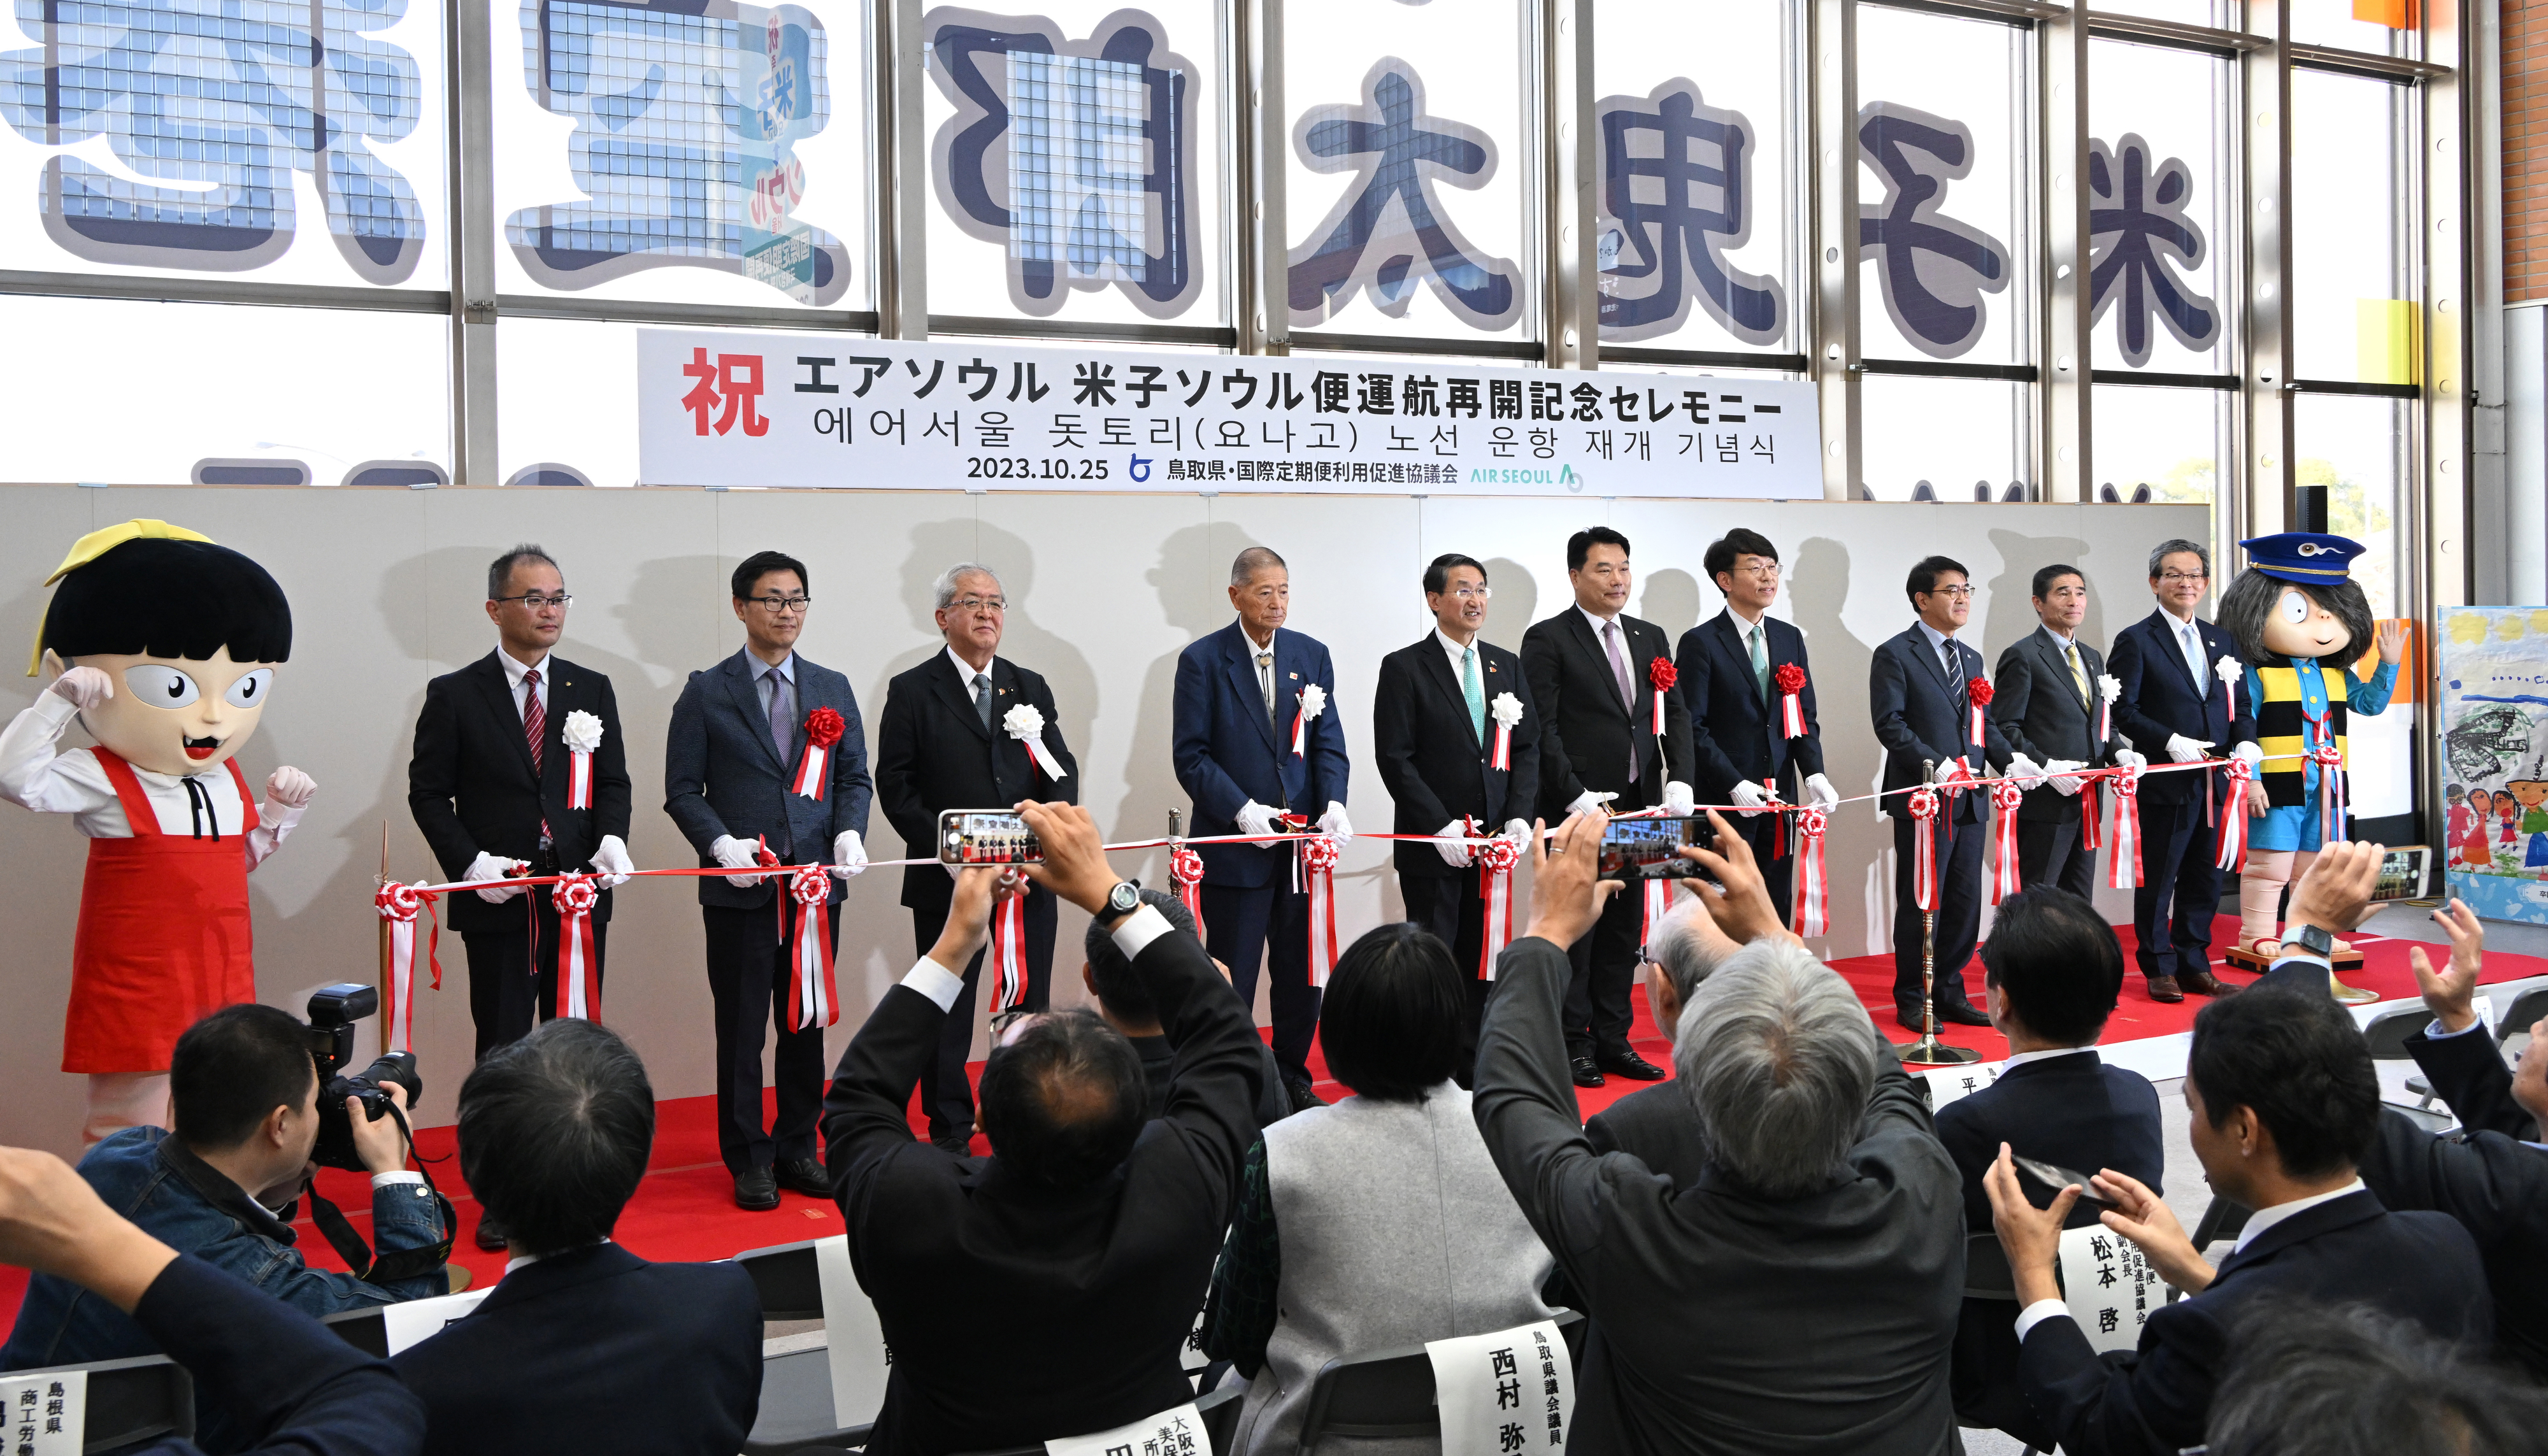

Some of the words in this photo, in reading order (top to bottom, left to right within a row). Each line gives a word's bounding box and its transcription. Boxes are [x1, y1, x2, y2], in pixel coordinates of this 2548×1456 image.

[682, 348, 769, 437] 祝
[794, 355, 1050, 403] エアソウル
[1073, 361, 1782, 425] 米子ソウル便運航再開記念セレモニー
[814, 407, 1015, 448] 에어서울
[1049, 414, 1358, 453] 돗토리(요나고)
[1386, 423, 1459, 457] 노선
[1487, 426, 1555, 459] 운항
[1585, 428, 1650, 462] 재개
[1678, 431, 1775, 465] 기념식
[967, 456, 1109, 481] 2023.10.25
[1470, 468, 1499, 483] AIR
[1501, 469, 1554, 484] SEOUL
[2539, 890, 2548, 899] 卒
[1961, 1076, 1977, 1094] 平
[2090, 1234, 2117, 1289] 松本
[2115, 1234, 2133, 1278] 副会長
[2098, 1306, 2119, 1334] 啓
[1489, 1346, 1521, 1411] 西村
[1533, 1331, 1563, 1446] 鳥取県議会議員
[45, 1381, 66, 1434] 島根県
